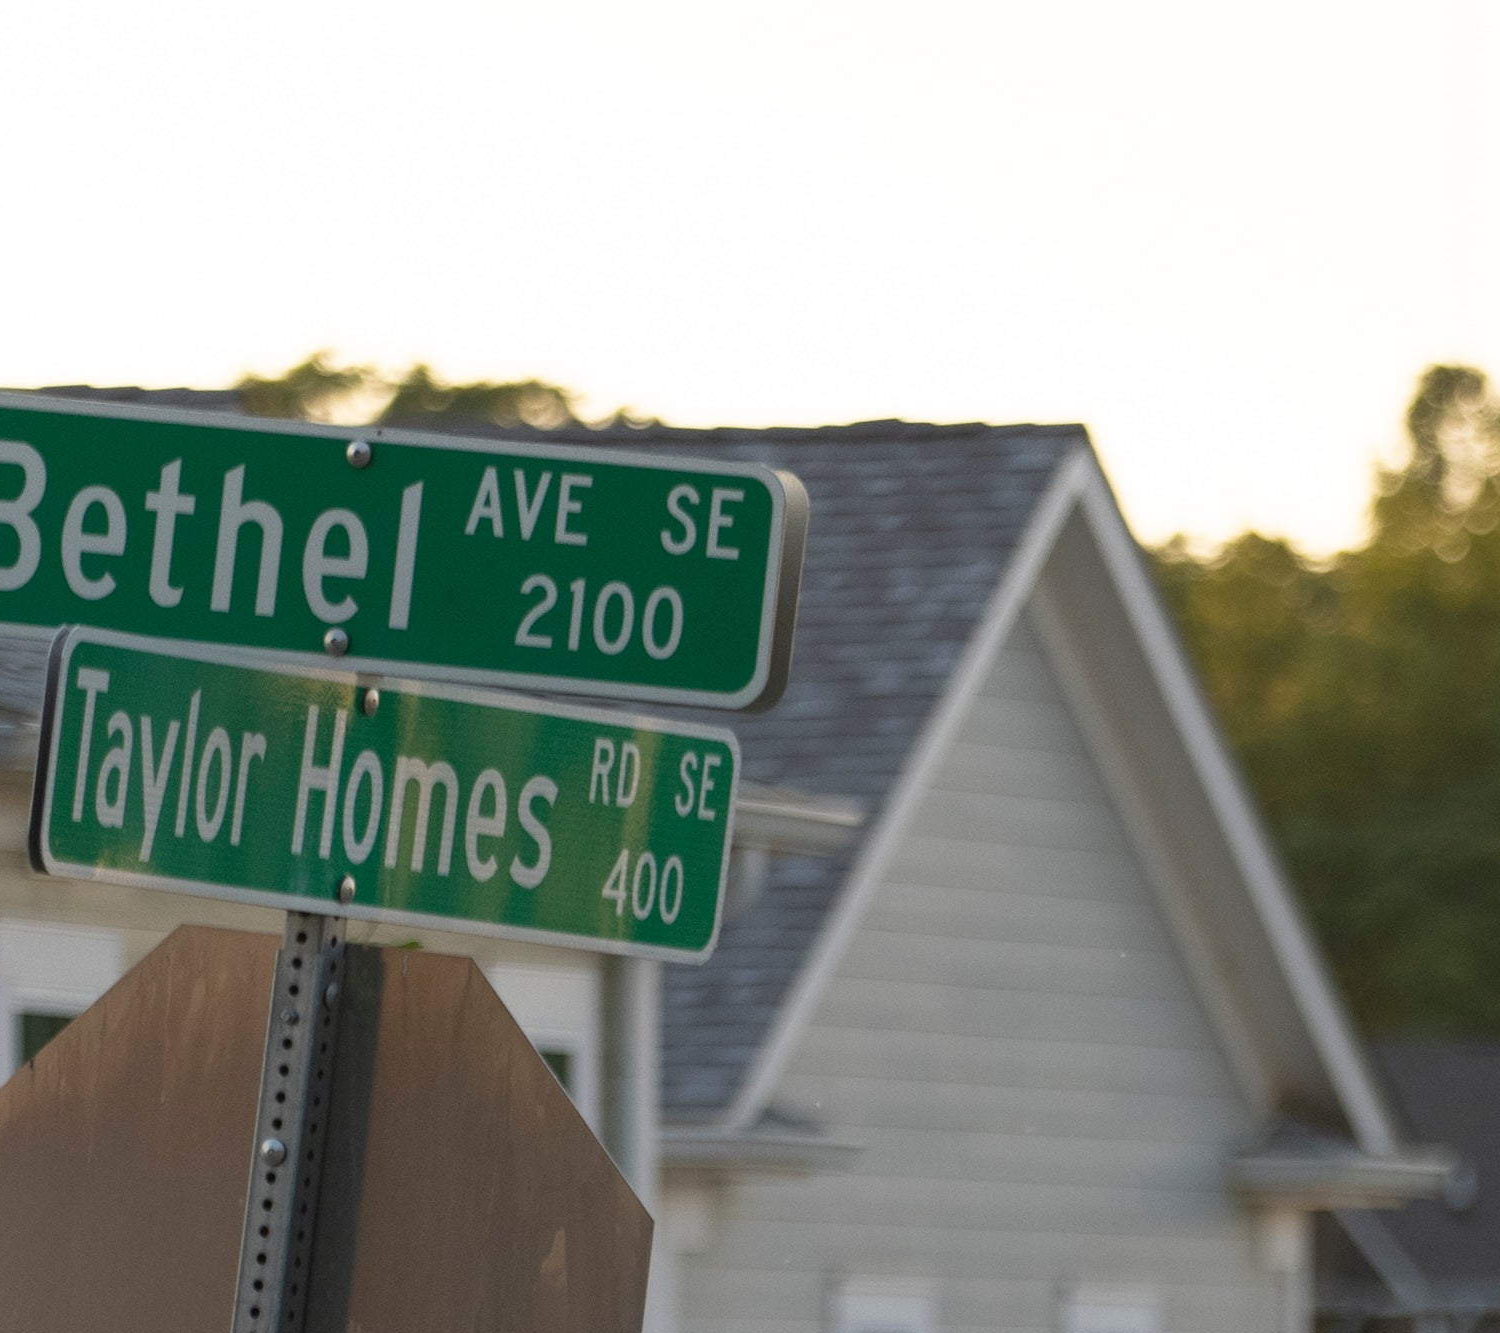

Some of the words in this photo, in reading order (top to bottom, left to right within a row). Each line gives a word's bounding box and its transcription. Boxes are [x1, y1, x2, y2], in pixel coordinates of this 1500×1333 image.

[466, 466, 594, 546] AVE
[660, 484, 745, 560] SE
[515, 574, 684, 660] 2100
[71, 666, 268, 863] Taylor
[291, 703, 559, 890] Homes
[589, 736, 641, 808] RD
[674, 751, 722, 821] SE
[601, 847, 684, 924] 400
